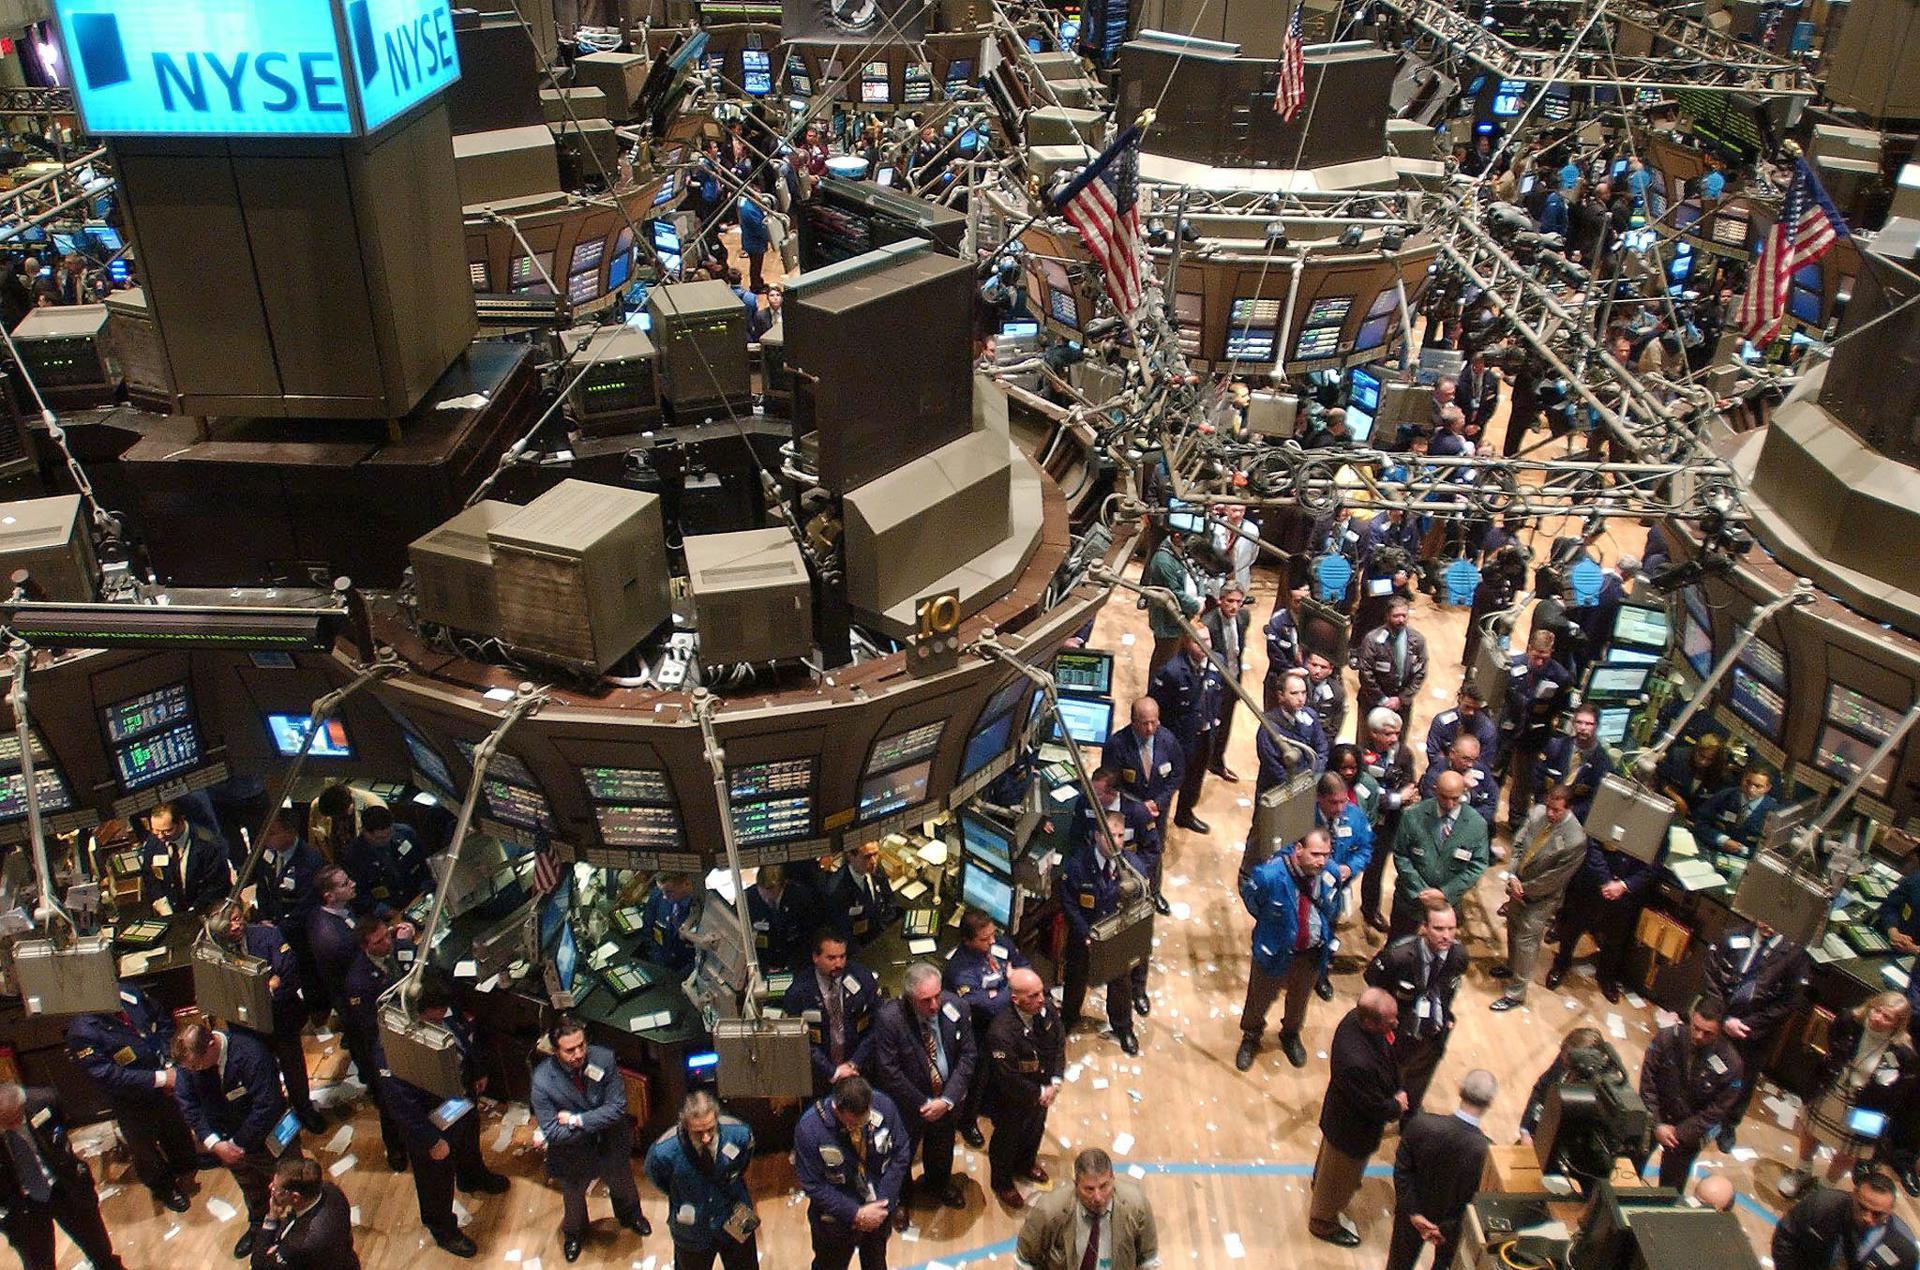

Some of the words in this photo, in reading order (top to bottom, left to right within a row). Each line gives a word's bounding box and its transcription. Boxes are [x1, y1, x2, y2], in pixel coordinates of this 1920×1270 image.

[384, 6, 454, 97] NYSE
[151, 52, 347, 112] NYSE
[917, 595, 961, 639] 10
